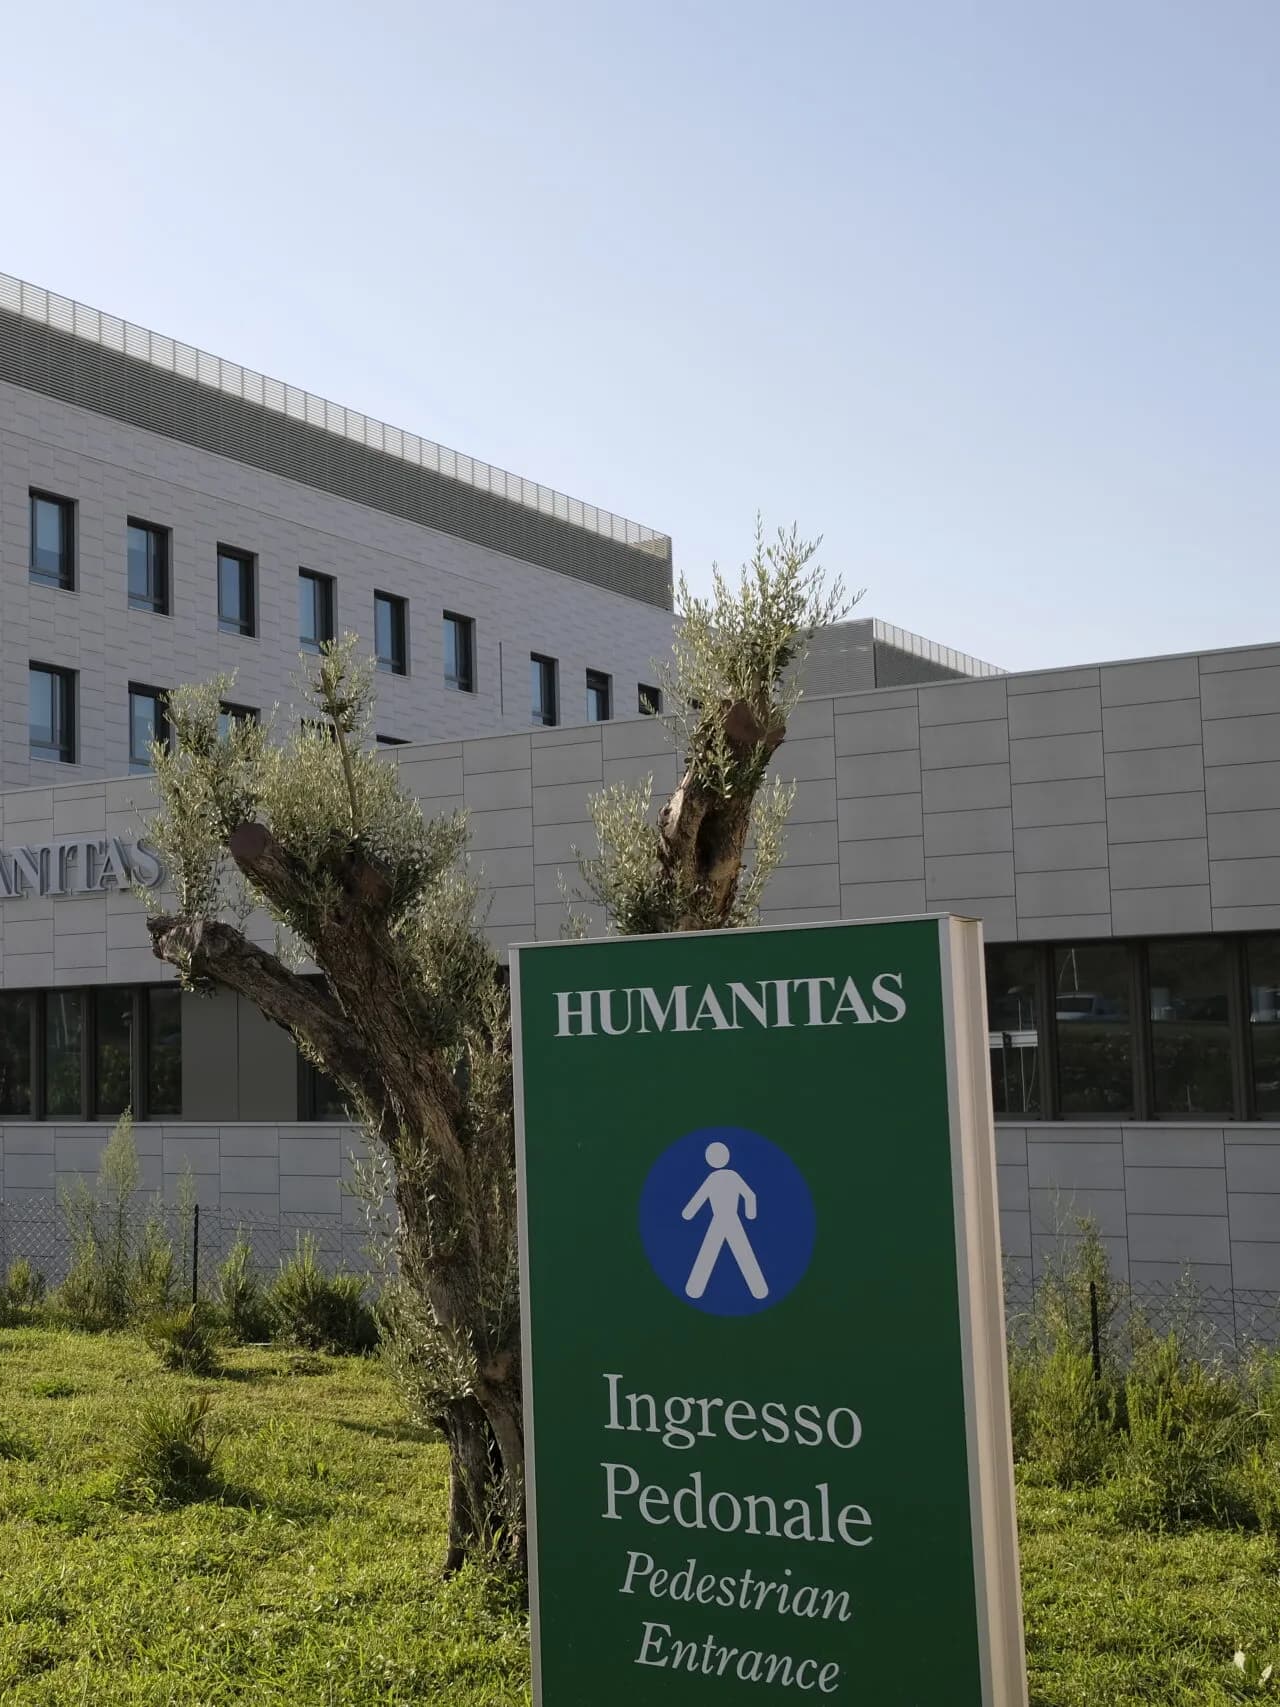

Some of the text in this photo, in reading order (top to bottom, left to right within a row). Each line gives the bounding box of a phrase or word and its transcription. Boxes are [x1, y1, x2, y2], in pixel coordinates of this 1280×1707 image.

[553, 974, 906, 1036] HUMANITAS
[603, 1374, 861, 1449] Ingresso
[601, 1463, 872, 1546] Pedonale
[619, 1551, 851, 1621] Pedestrian
[635, 1622, 839, 1692] Entrance
